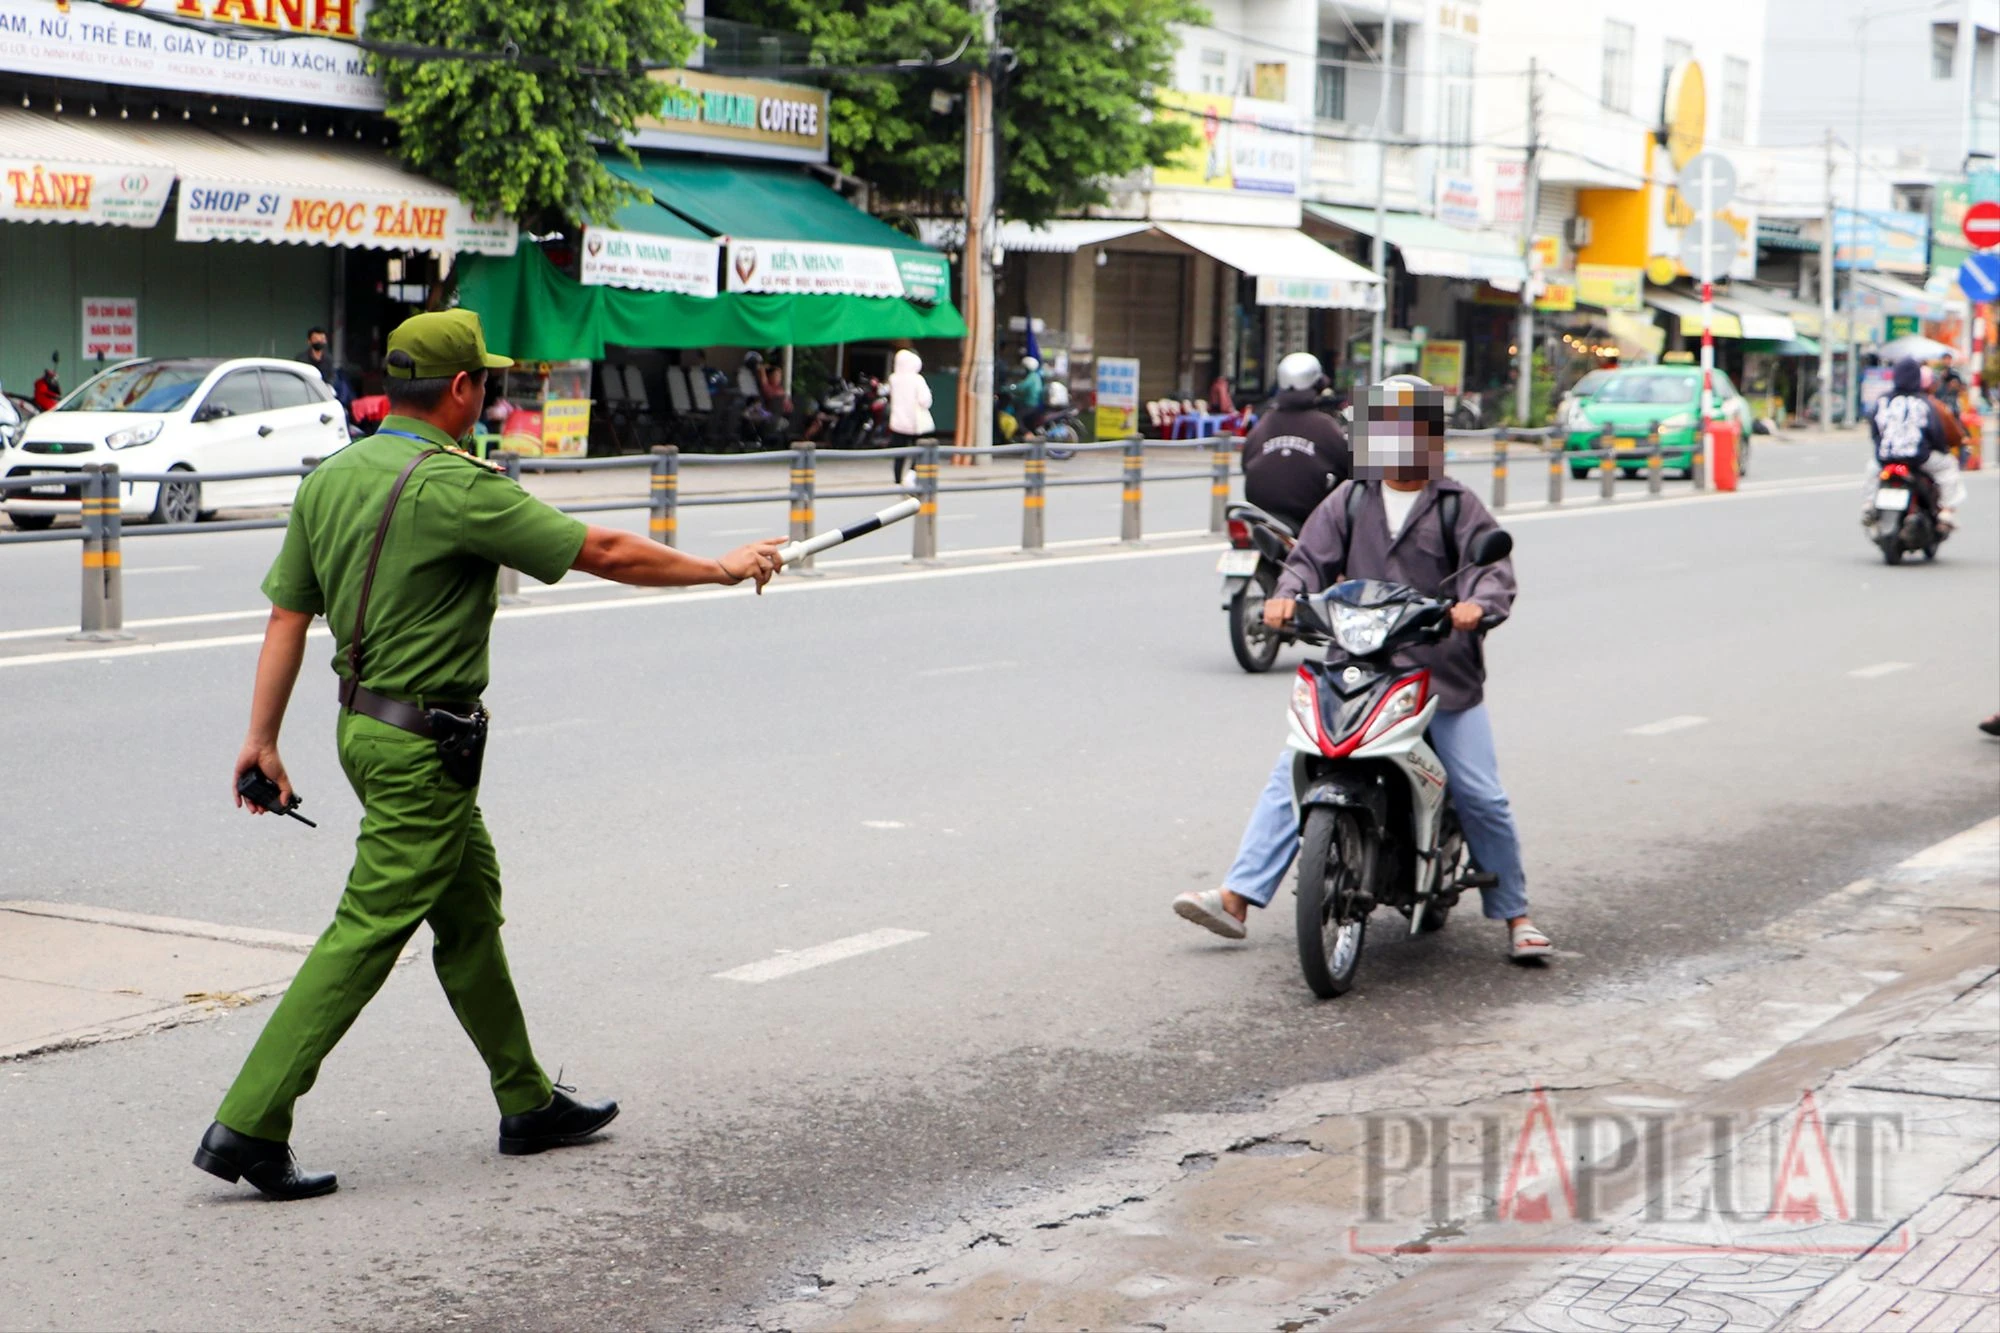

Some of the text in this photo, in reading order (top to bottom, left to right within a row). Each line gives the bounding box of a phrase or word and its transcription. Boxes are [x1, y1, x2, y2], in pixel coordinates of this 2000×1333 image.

[125, 31, 157, 51] EM,
[291, 51, 342, 75] XÁCH,
[702, 88, 757, 129] NHANH
[759, 96, 819, 136] COFFEE
[190, 188, 250, 212] SHOP
[284, 197, 366, 241] NGỌC
